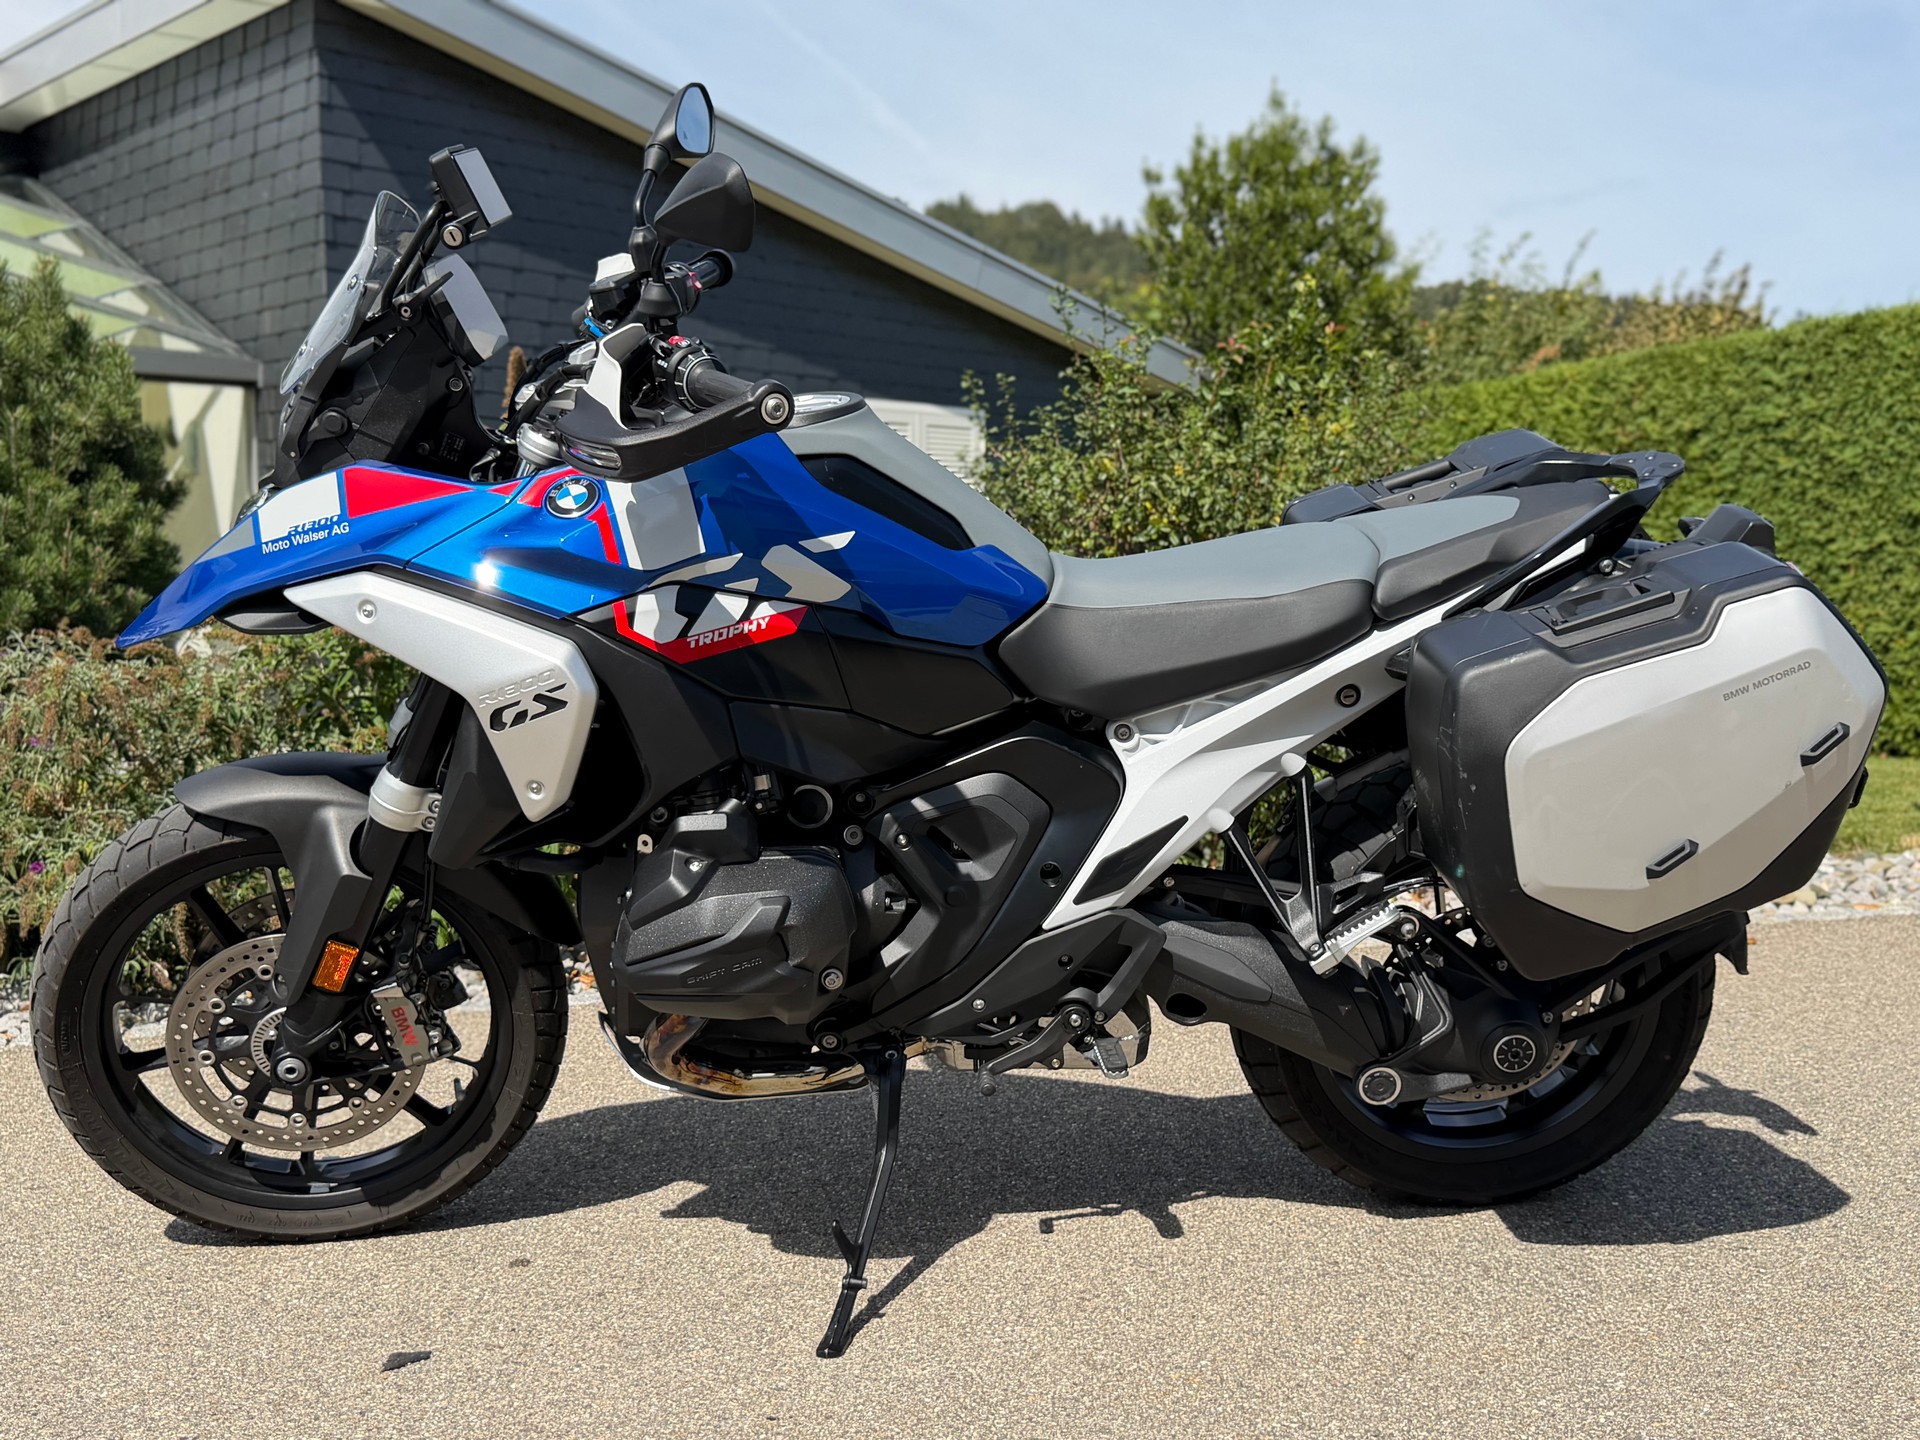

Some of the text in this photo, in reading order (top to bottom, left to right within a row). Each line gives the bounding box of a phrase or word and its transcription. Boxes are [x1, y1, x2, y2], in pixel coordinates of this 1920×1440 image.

[261, 522, 350, 555] Moto Walser AG
[686, 616, 771, 649] TROPHY
[1722, 660, 1812, 702] BMW MOTORRAD
[489, 682, 569, 732] GS
[687, 968, 725, 984] SHIFT
[391, 1007, 420, 1046] BMW
